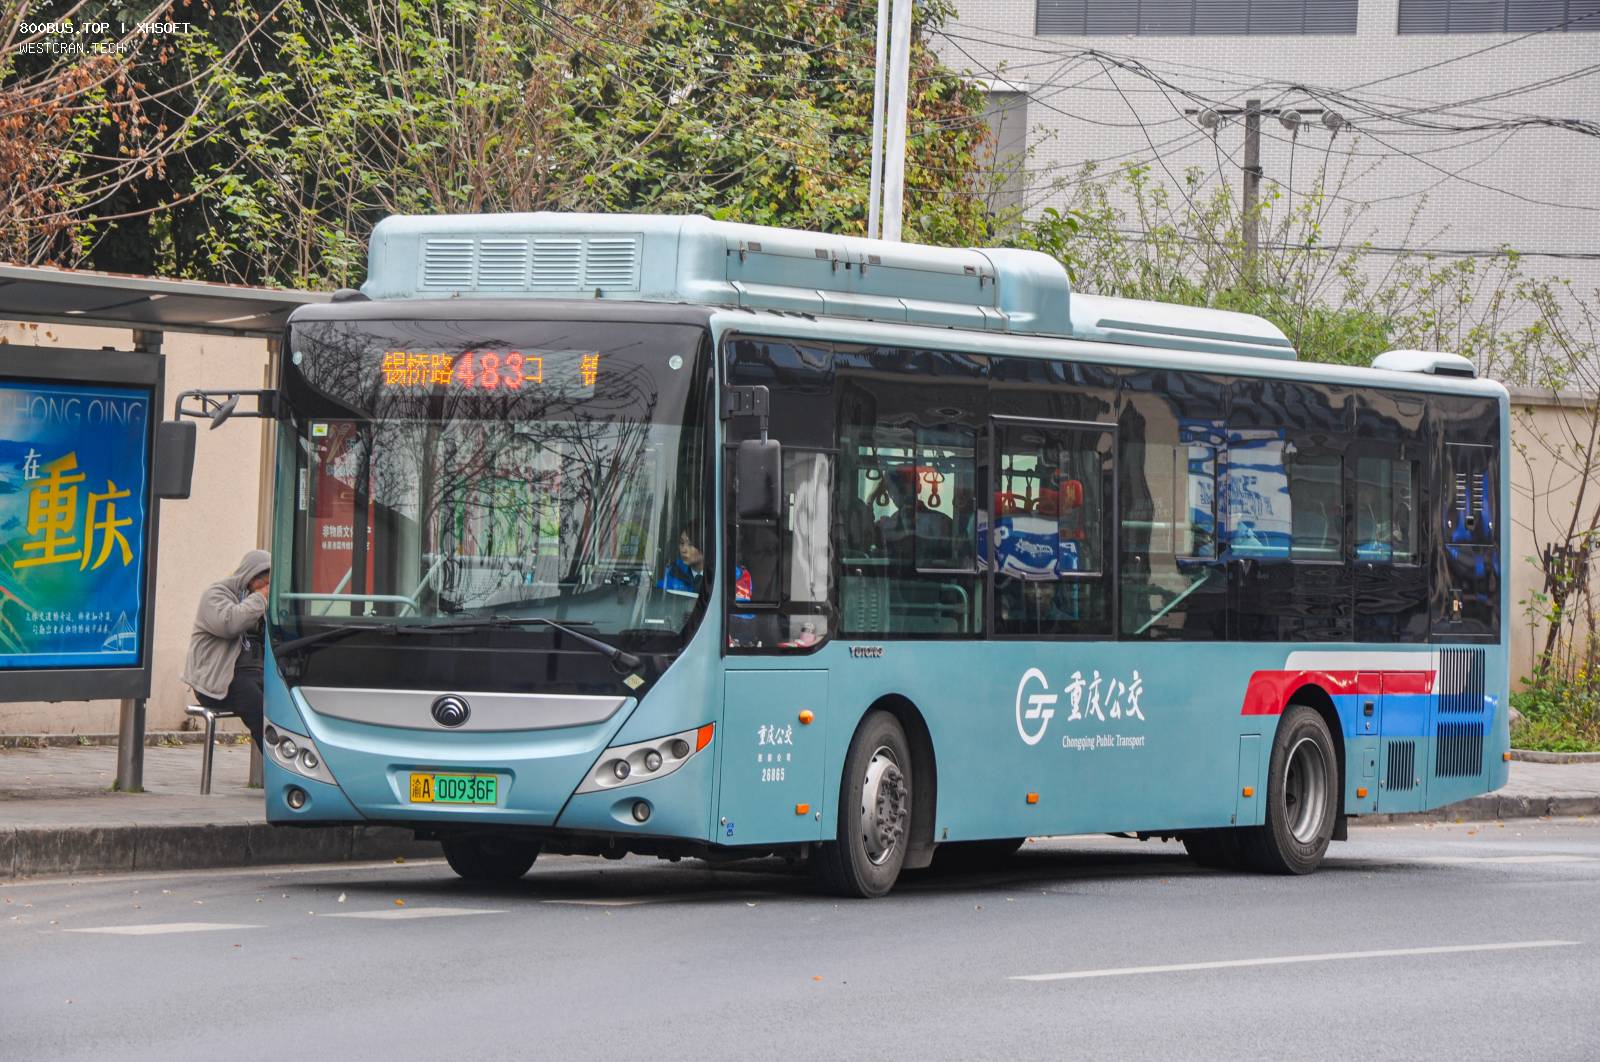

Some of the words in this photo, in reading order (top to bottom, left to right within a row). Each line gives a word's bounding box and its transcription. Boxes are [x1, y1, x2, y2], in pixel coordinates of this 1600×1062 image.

[457, 351, 524, 389] 483
[22, 448, 42, 481] 在
[13, 450, 134, 572] 重庆
[1064, 669, 1146, 722] 重庆公交
[757, 724, 793, 746] 重庆公交
[1062, 734, 1096, 751] Chongqing
[1096, 733, 1115, 747] Public
[1115, 734, 1146, 750] Transport
